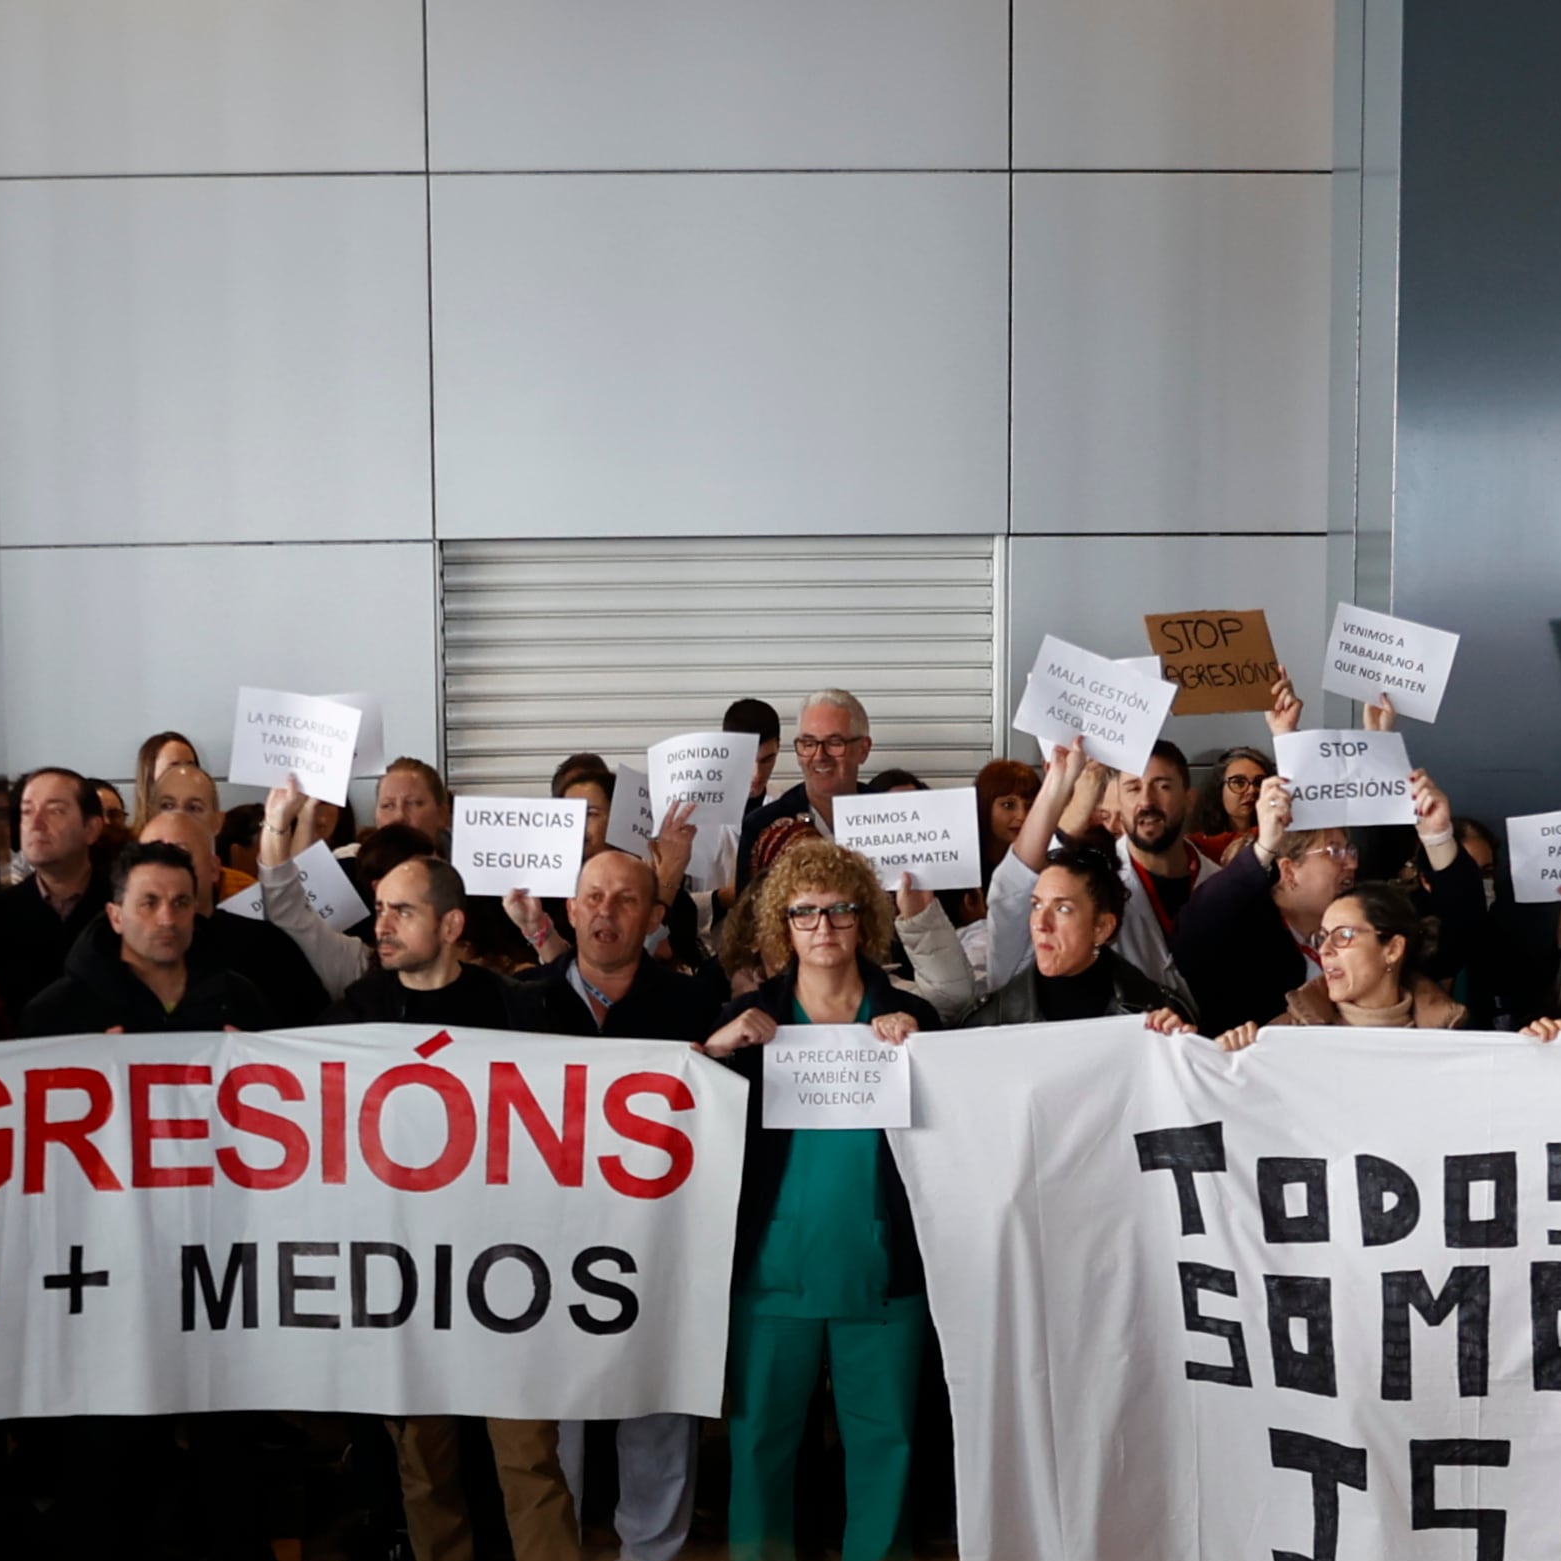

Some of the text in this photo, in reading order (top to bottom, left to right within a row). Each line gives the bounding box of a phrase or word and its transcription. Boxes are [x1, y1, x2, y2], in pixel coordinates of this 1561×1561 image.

[1161, 617, 1243, 654] STOP
[1342, 622, 1405, 648] VENIMOS A
[1047, 663, 1086, 688] MALA
[1165, 660, 1282, 690] AGRESIÓNS
[1334, 660, 1427, 693] QUE NOS MATEN
[1416, 662, 1425, 673] A
[1058, 690, 1127, 725] AGRESIÓN
[247, 712, 350, 742] LA PRECARIEDAD
[1046, 706, 1125, 745] ASEGURADA
[261, 733, 319, 753] TAMBIÉN
[321, 744, 334, 758] ES
[667, 747, 730, 765] DIGNIDAD
[1320, 742, 1368, 758] STOP
[264, 753, 327, 776] VIOLENCIA
[670, 769, 723, 784] PARA OS
[1291, 778, 1406, 801] AGRESIÓNS
[464, 809, 575, 829] URXENCIAS
[846, 811, 920, 826] VENIMOS A
[941, 829, 951, 840] A
[472, 850, 563, 870] SEGURAS
[880, 854, 908, 866] NOS
[911, 850, 959, 863] MATEN
[776, 1049, 899, 1063] LA PRECARIEDAD
[792, 1067, 881, 1084] TAMBIÉN ES
[798, 1091, 876, 1105] VIOLENCIA
[181, 1242, 640, 1335] MEDIOS
